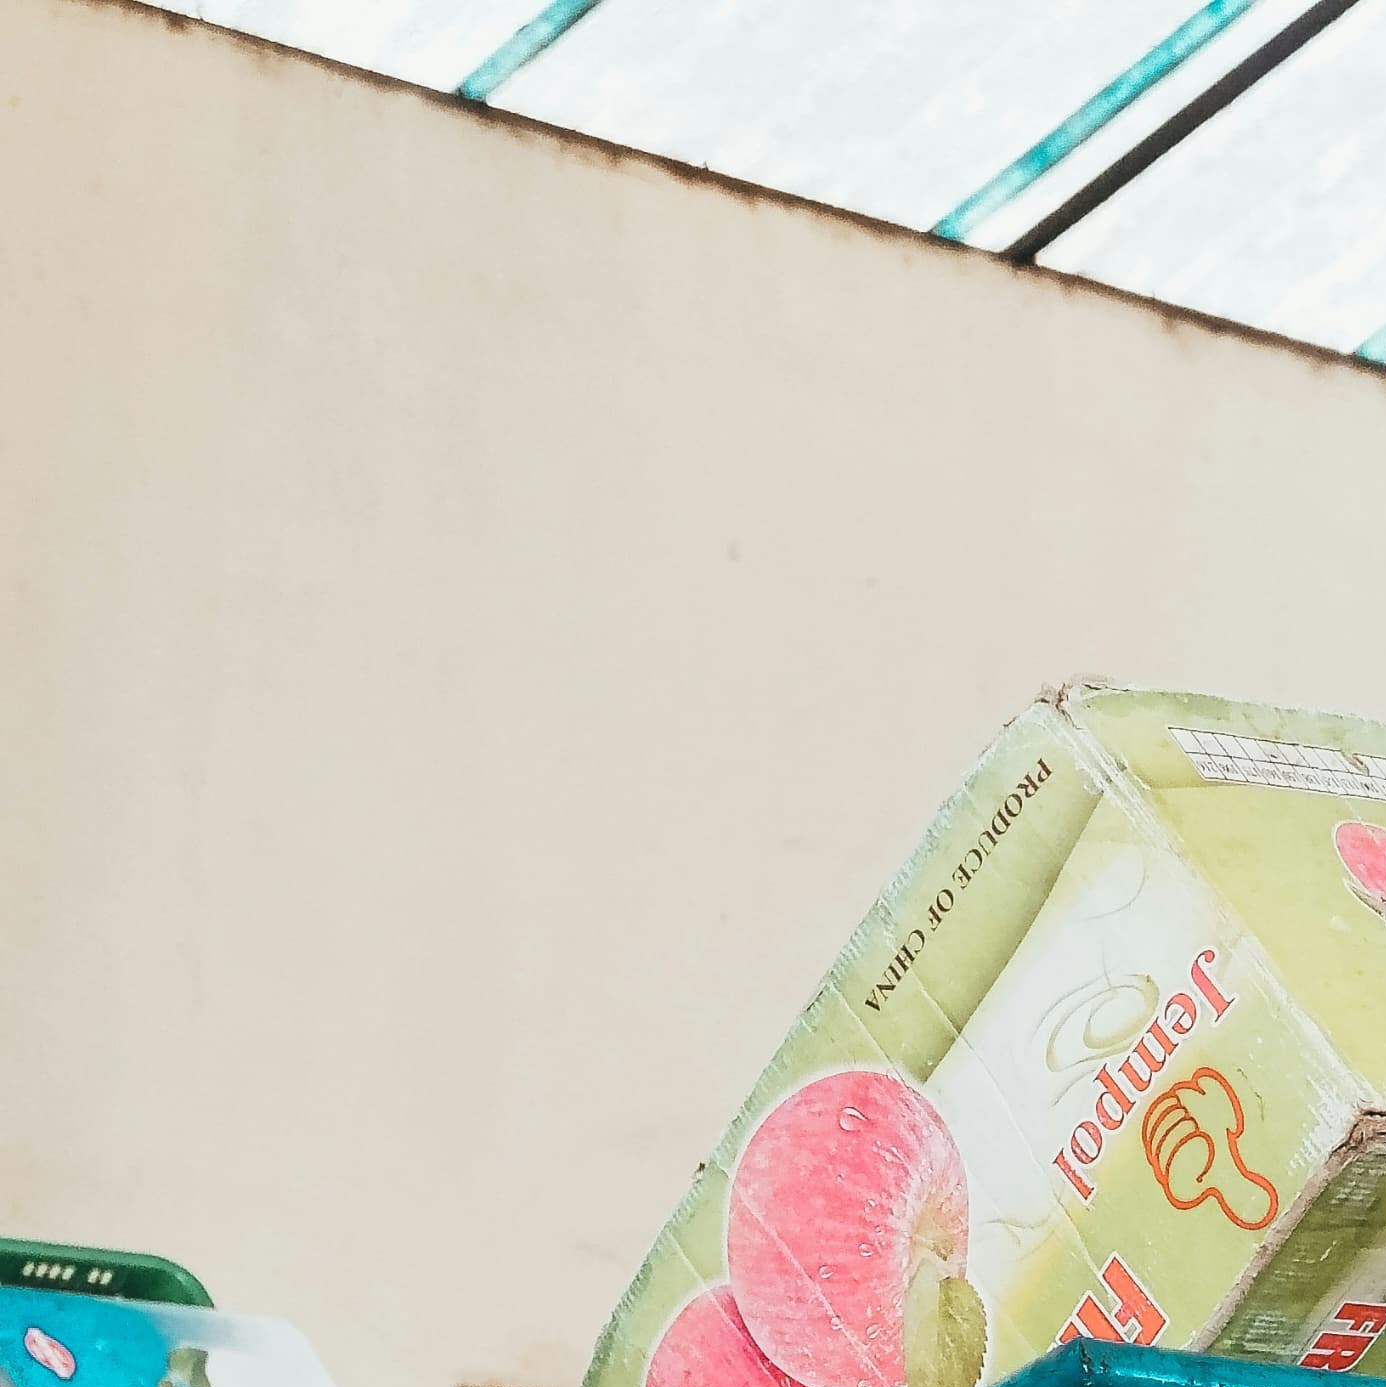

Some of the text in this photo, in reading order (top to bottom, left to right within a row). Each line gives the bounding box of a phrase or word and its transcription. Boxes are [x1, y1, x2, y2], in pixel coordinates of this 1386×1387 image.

[864, 757, 1053, 1012] PRODUCE OF CHINA
[1052, 948, 1238, 1206] Jempol
